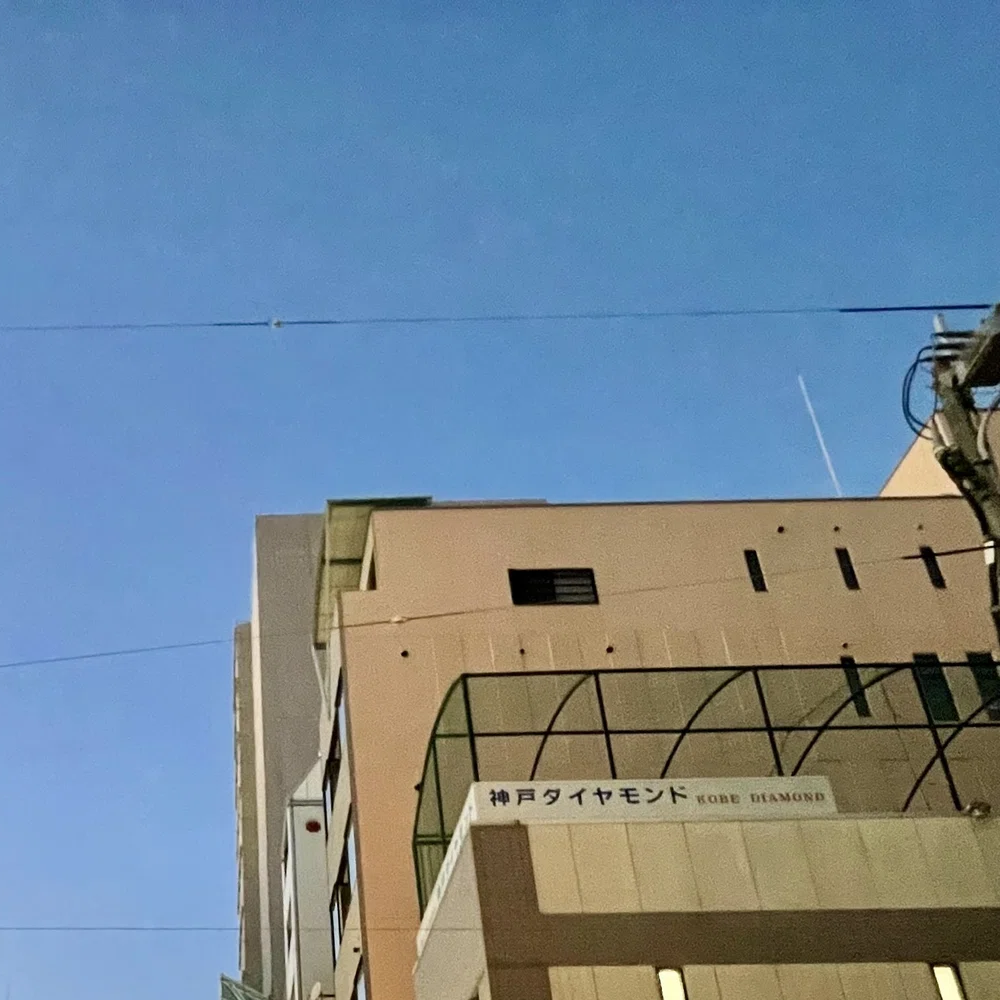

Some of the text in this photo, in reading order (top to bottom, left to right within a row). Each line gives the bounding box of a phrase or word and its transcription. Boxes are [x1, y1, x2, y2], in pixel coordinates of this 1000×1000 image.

[489, 786, 826, 807] 神戸ダイヤモンド KOBE DIAMOND
